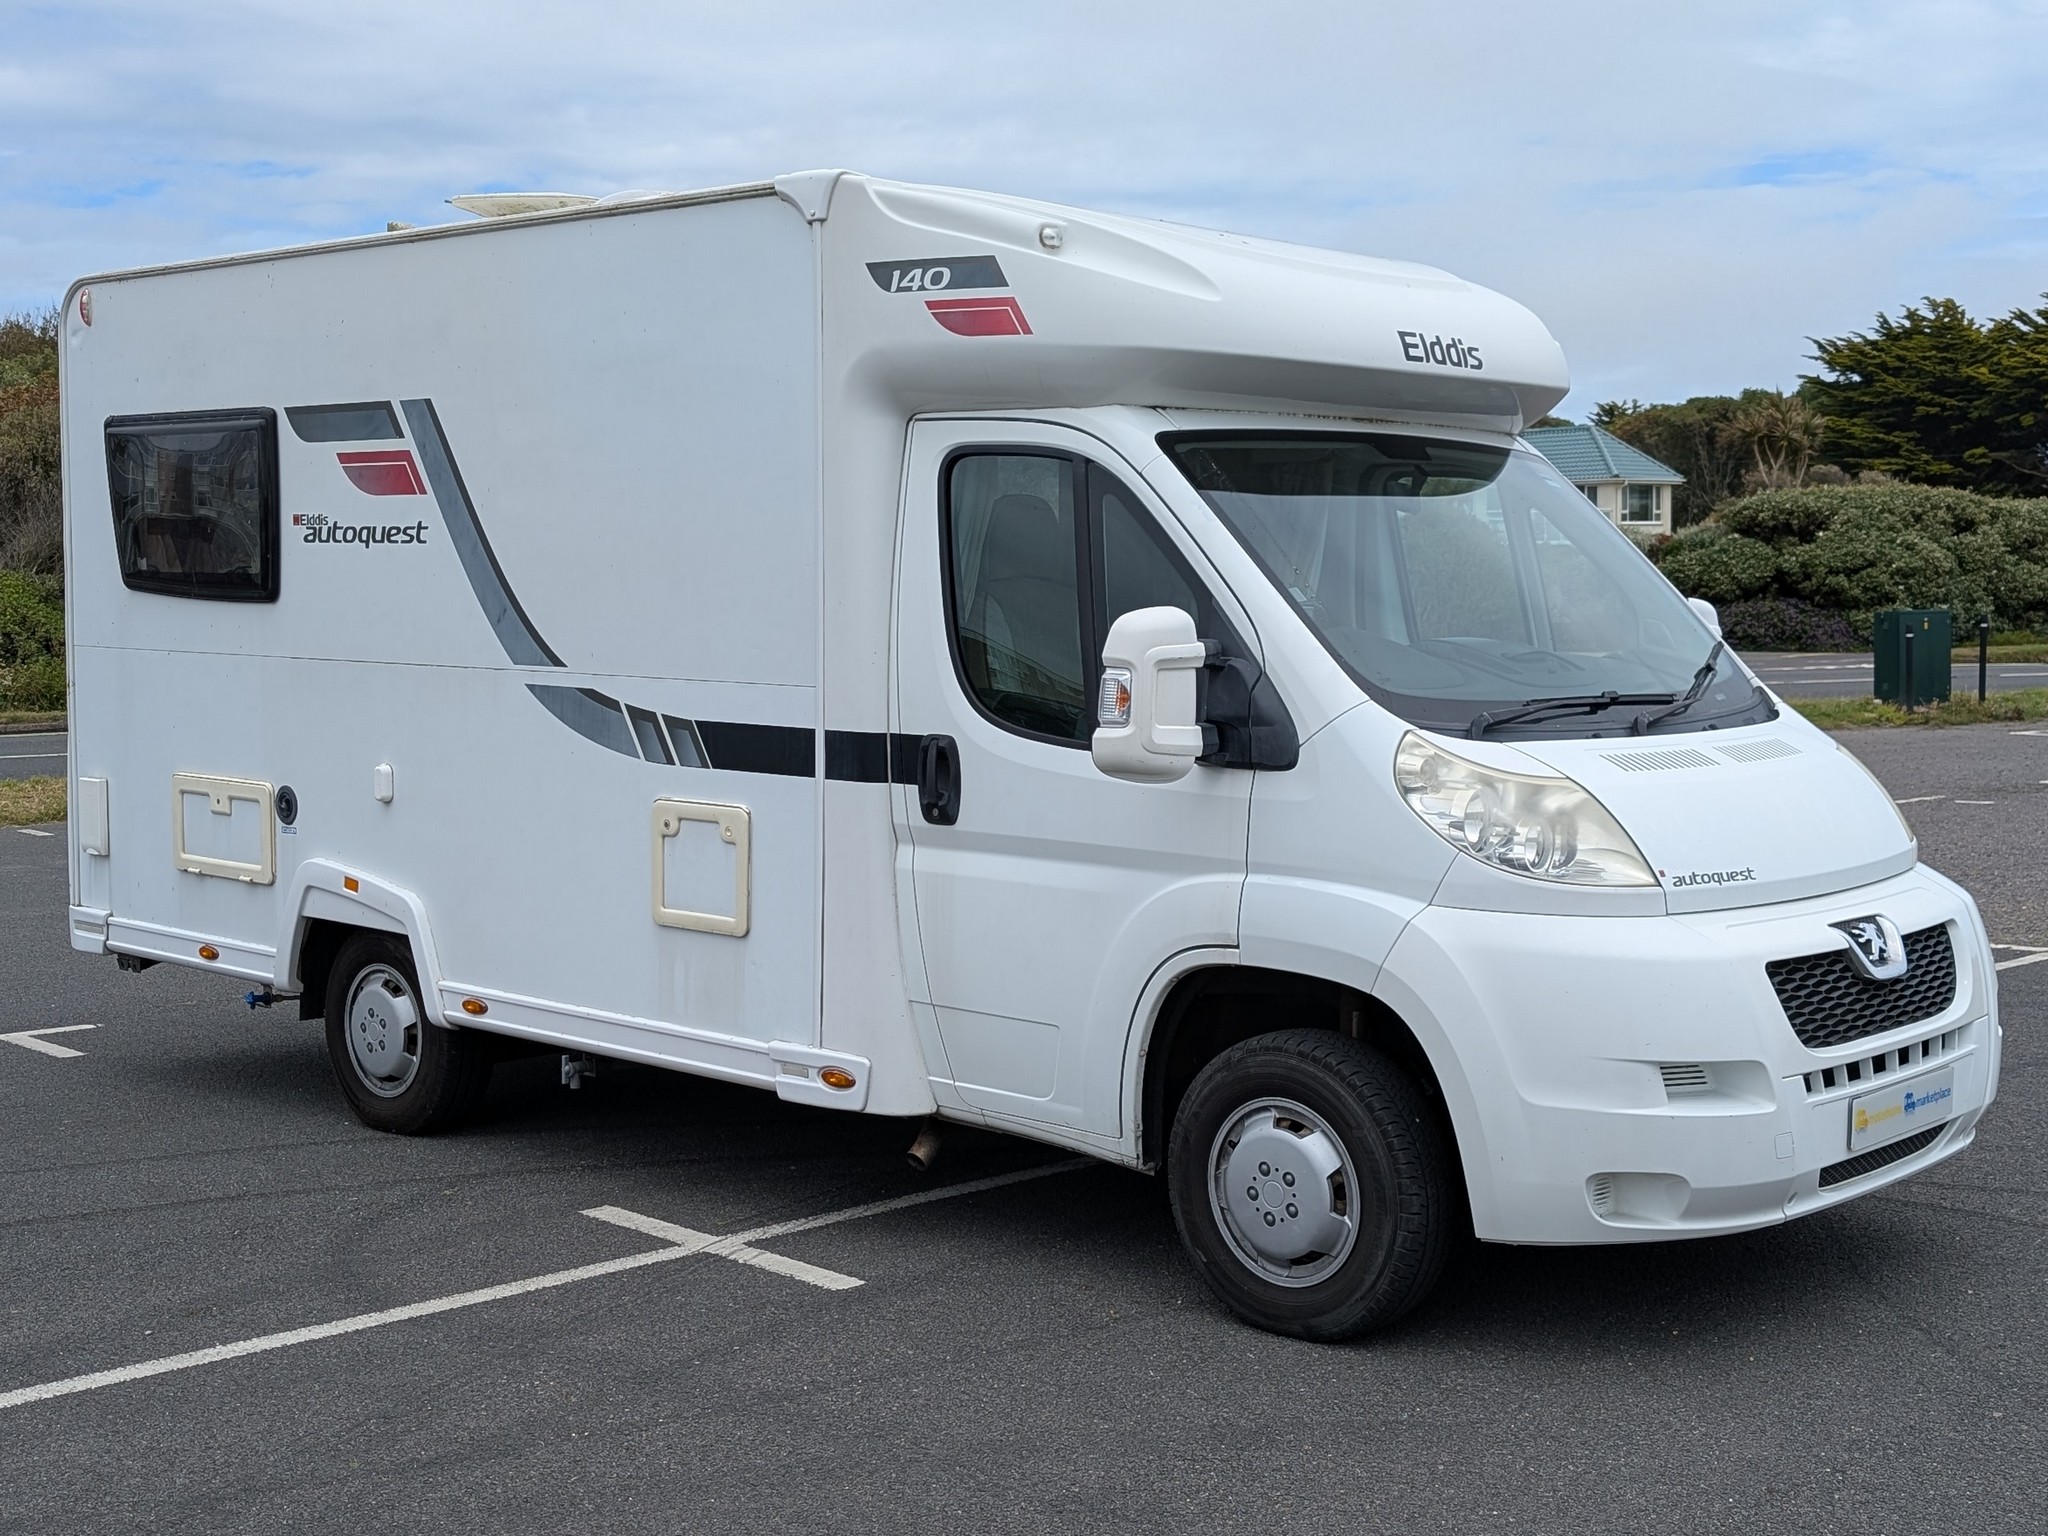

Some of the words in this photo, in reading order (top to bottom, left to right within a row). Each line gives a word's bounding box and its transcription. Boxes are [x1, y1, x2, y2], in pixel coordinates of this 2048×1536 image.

[890, 267, 950, 292] 140
[1397, 330, 1483, 370] Elddis
[300, 514, 328, 525] Elddis
[303, 521, 429, 549] autoquest
[1672, 867, 1756, 887] autoquest
